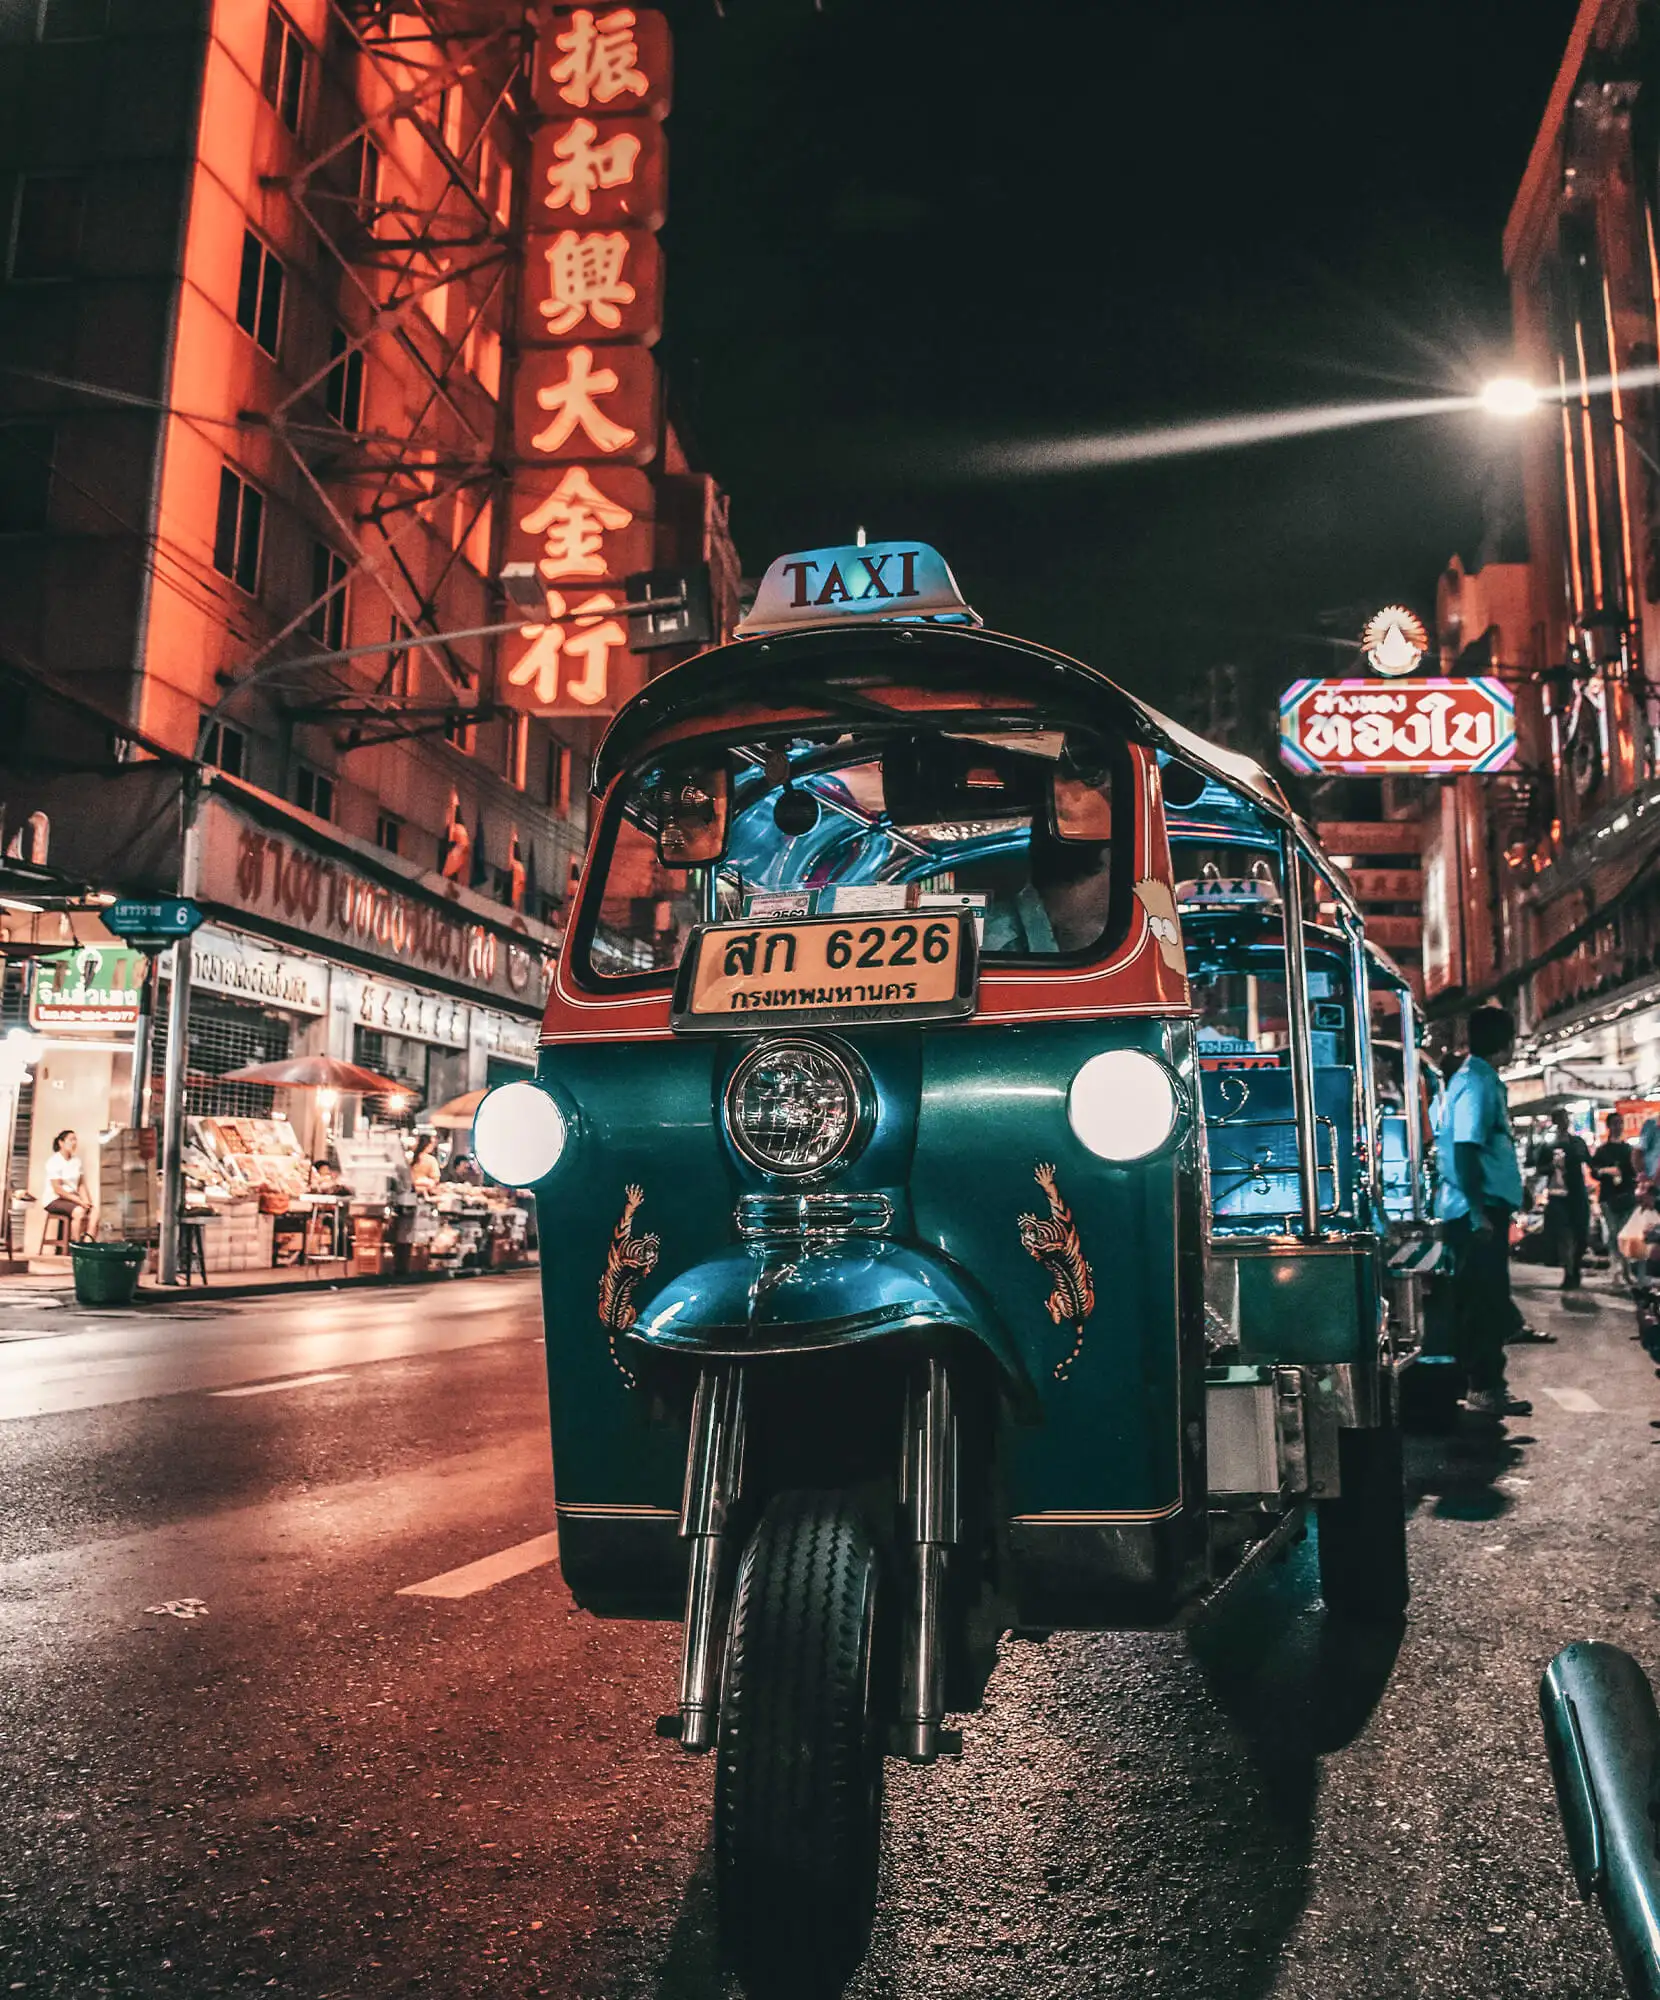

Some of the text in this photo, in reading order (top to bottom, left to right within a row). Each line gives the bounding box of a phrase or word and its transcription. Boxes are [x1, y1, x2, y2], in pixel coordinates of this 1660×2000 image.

[510, 8, 649, 704] 振和興大金行
[782, 551, 920, 607] TAXI
[1194, 881, 1257, 895] TAXI
[176, 907, 188, 925] 6
[724, 923, 950, 977] สก 6226
